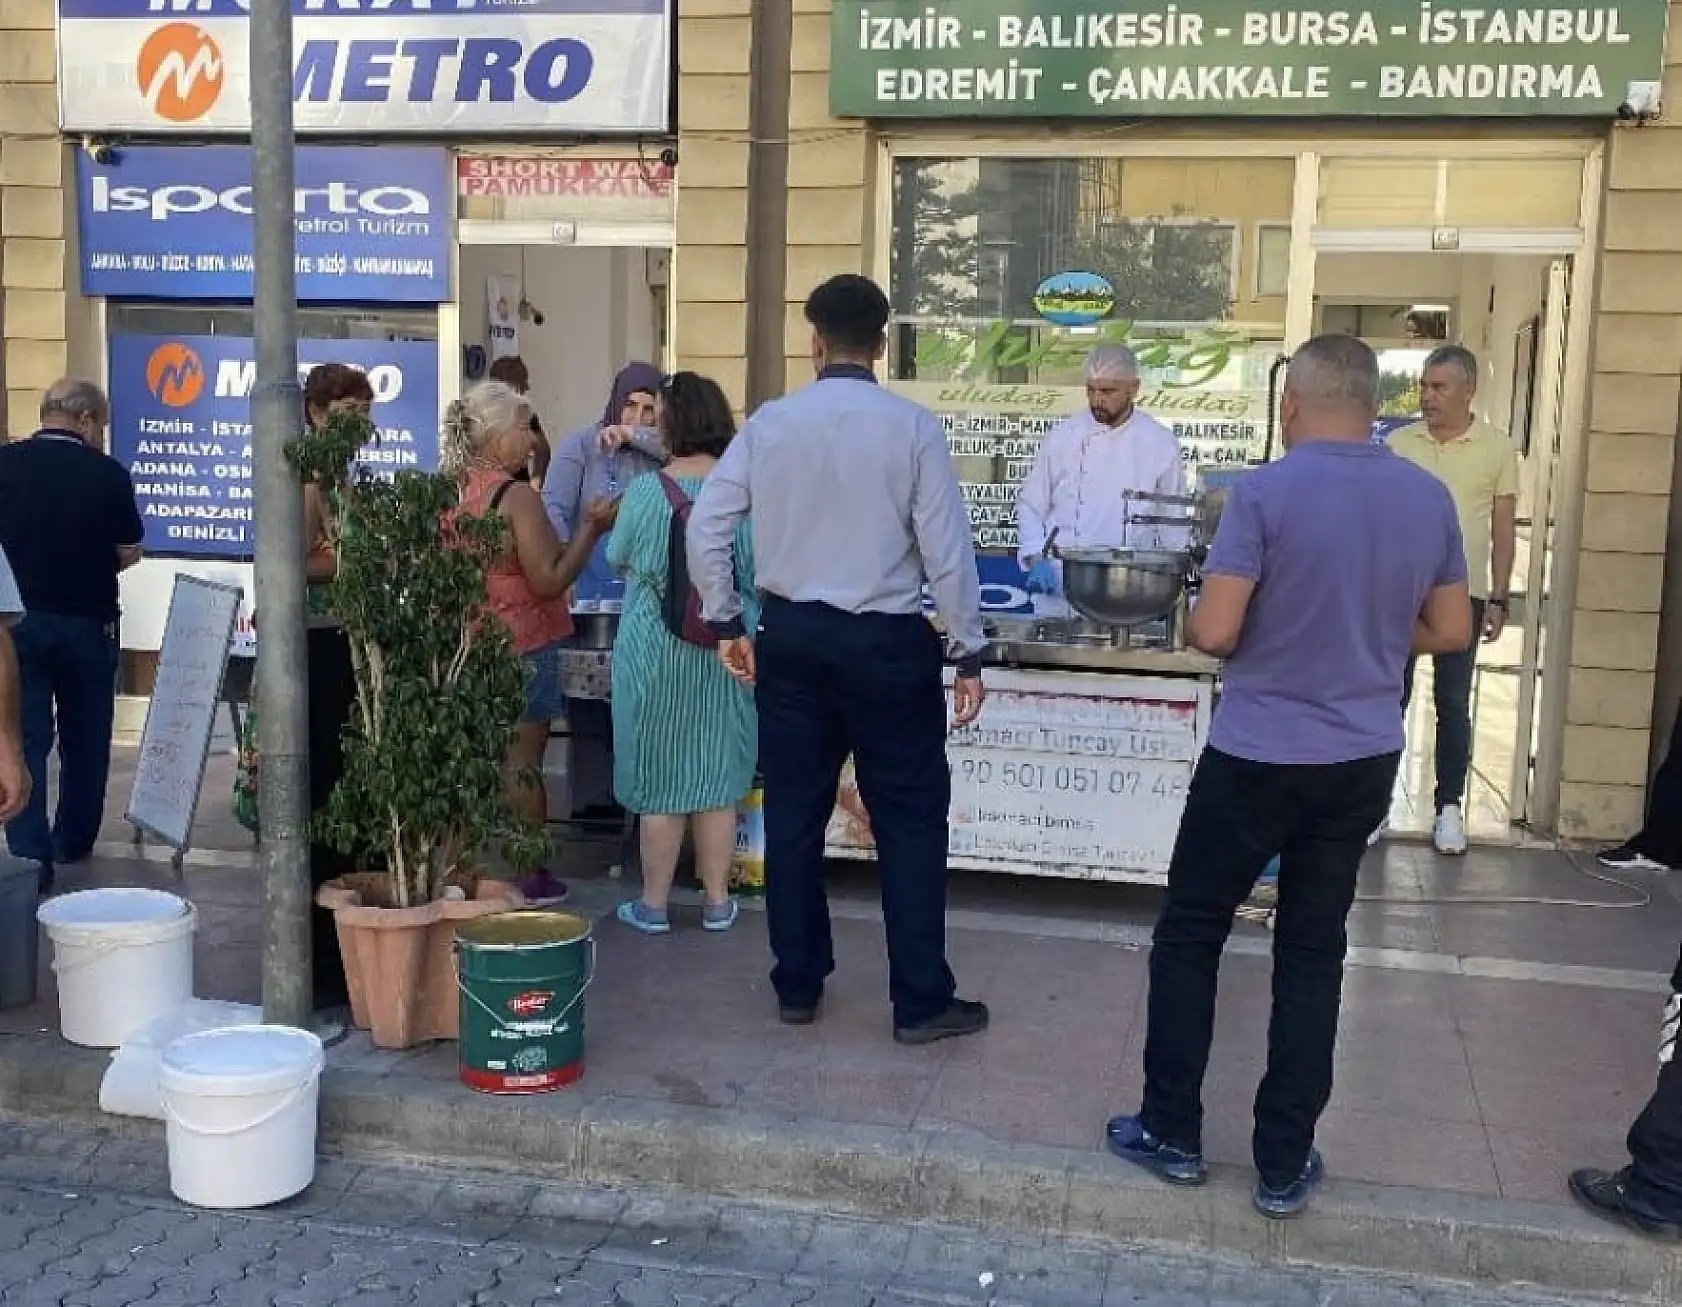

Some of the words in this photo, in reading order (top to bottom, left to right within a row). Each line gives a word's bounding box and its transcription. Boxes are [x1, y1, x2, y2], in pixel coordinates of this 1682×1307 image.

[860, 7, 962, 49] İZMİR
[998, 4, 1203, 48] BALIKESİR
[1243, 10, 1378, 46] BURSA
[1419, 2, 1630, 44] İSTANBUL
[293, 38, 594, 103] METRO
[877, 58, 1042, 101] EDREMİT
[1088, 66, 1330, 105] ÇANAKKALE
[1379, 64, 1604, 99] BANDIRMA
[469, 160, 583, 178] SHORT
[593, 161, 662, 179] WAY
[294, 217, 349, 234] etrol
[1173, 420, 1254, 439] BALIKESİR
[137, 442, 224, 456] ANTALYA
[130, 461, 197, 476] ADANA
[1003, 763, 1047, 790] 501
[1054, 765, 1099, 793] 051
[1109, 770, 1142, 797] 07
